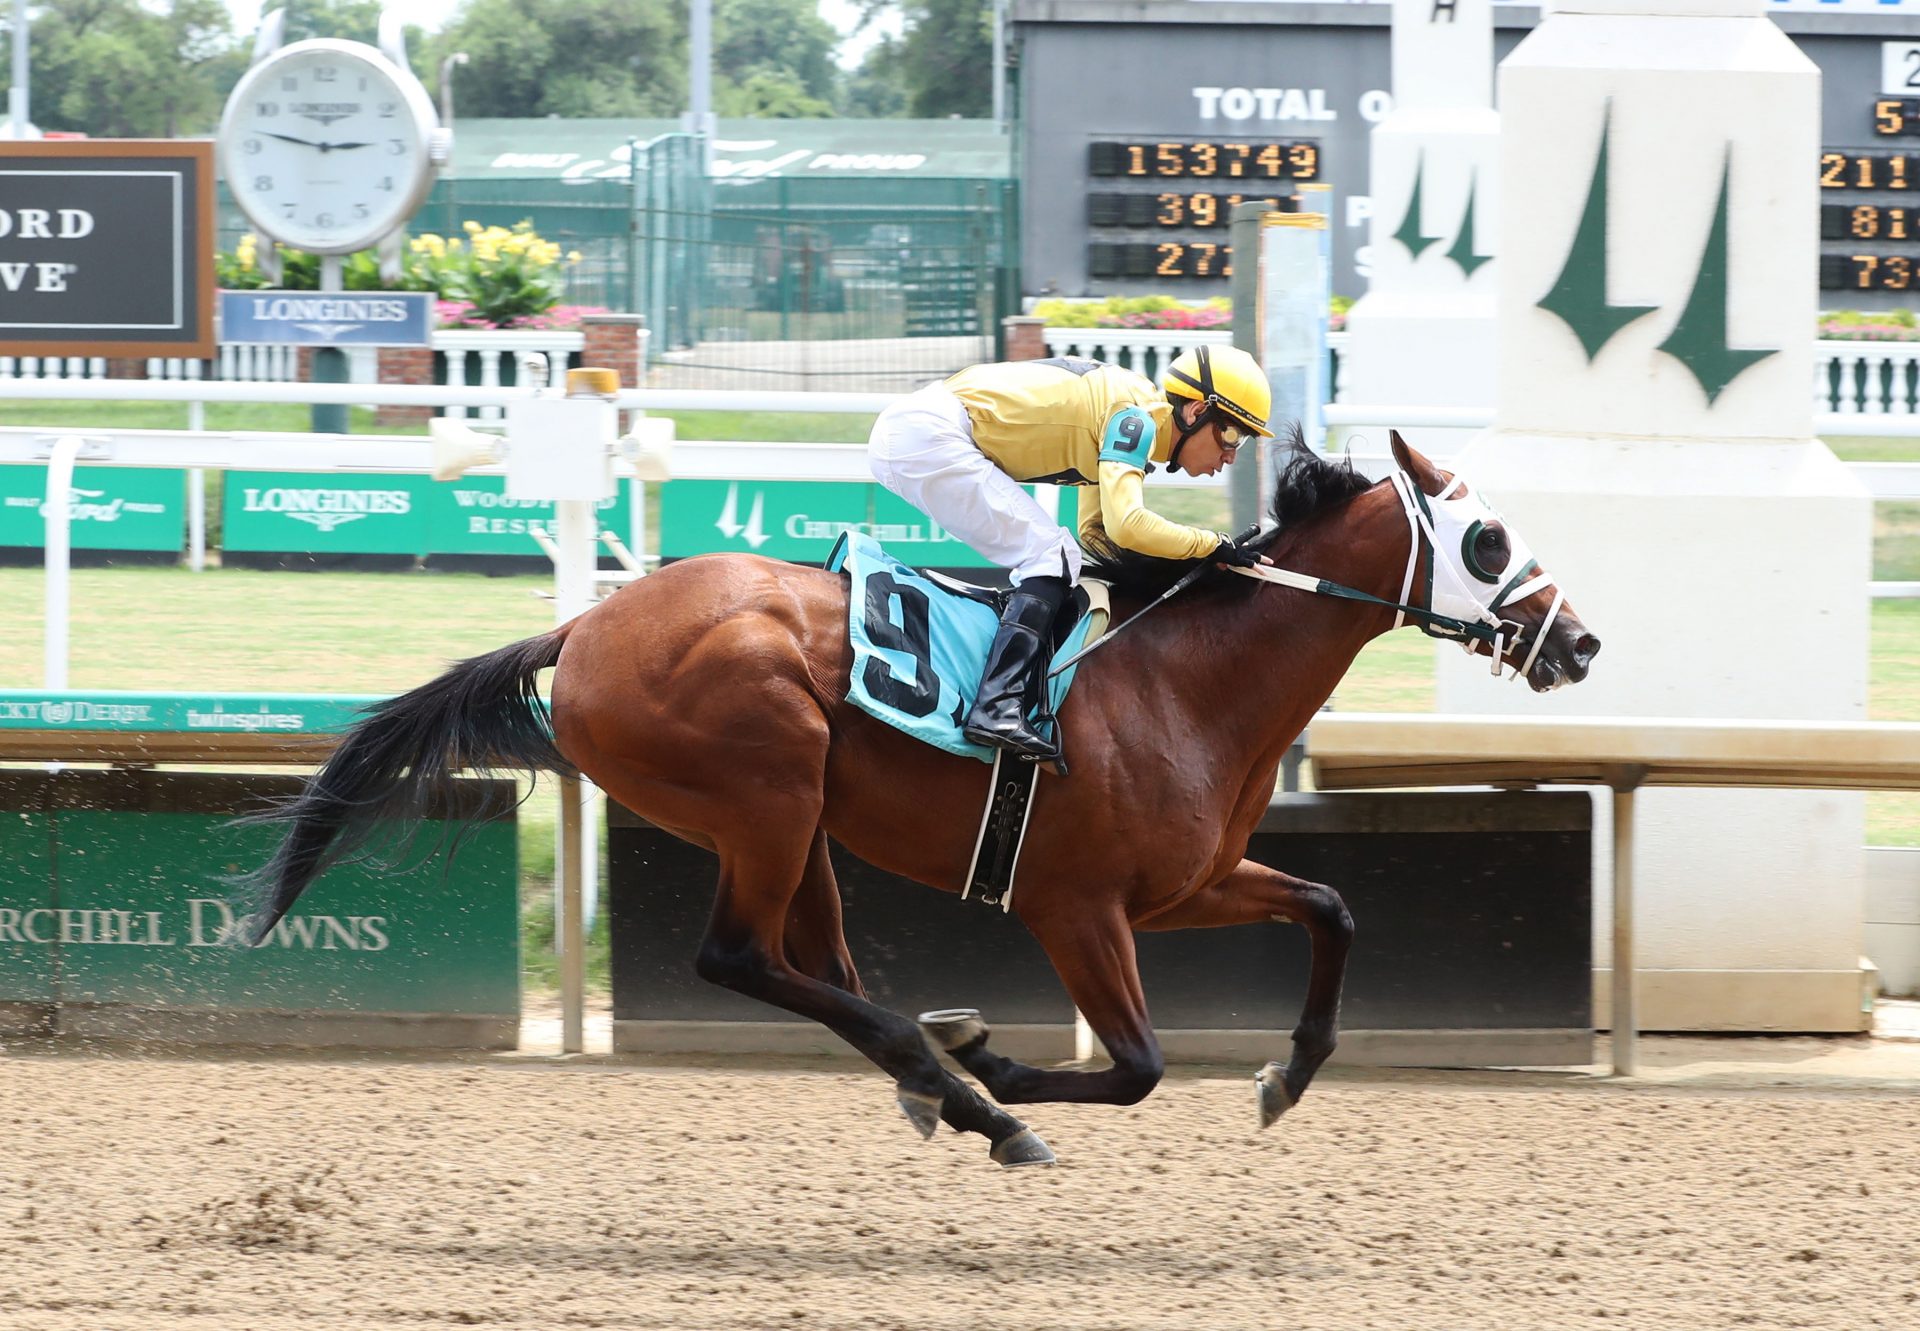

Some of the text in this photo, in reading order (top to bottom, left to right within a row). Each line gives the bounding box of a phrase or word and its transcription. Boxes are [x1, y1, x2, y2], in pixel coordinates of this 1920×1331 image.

[1193, 87, 1337, 120] TOTAL
[1128, 143, 1316, 178] 153749
[253, 299, 408, 321] LONGINES
[1113, 416, 1144, 452] 9
[243, 488, 410, 514] LONGINES
[863, 571, 941, 719] 9
